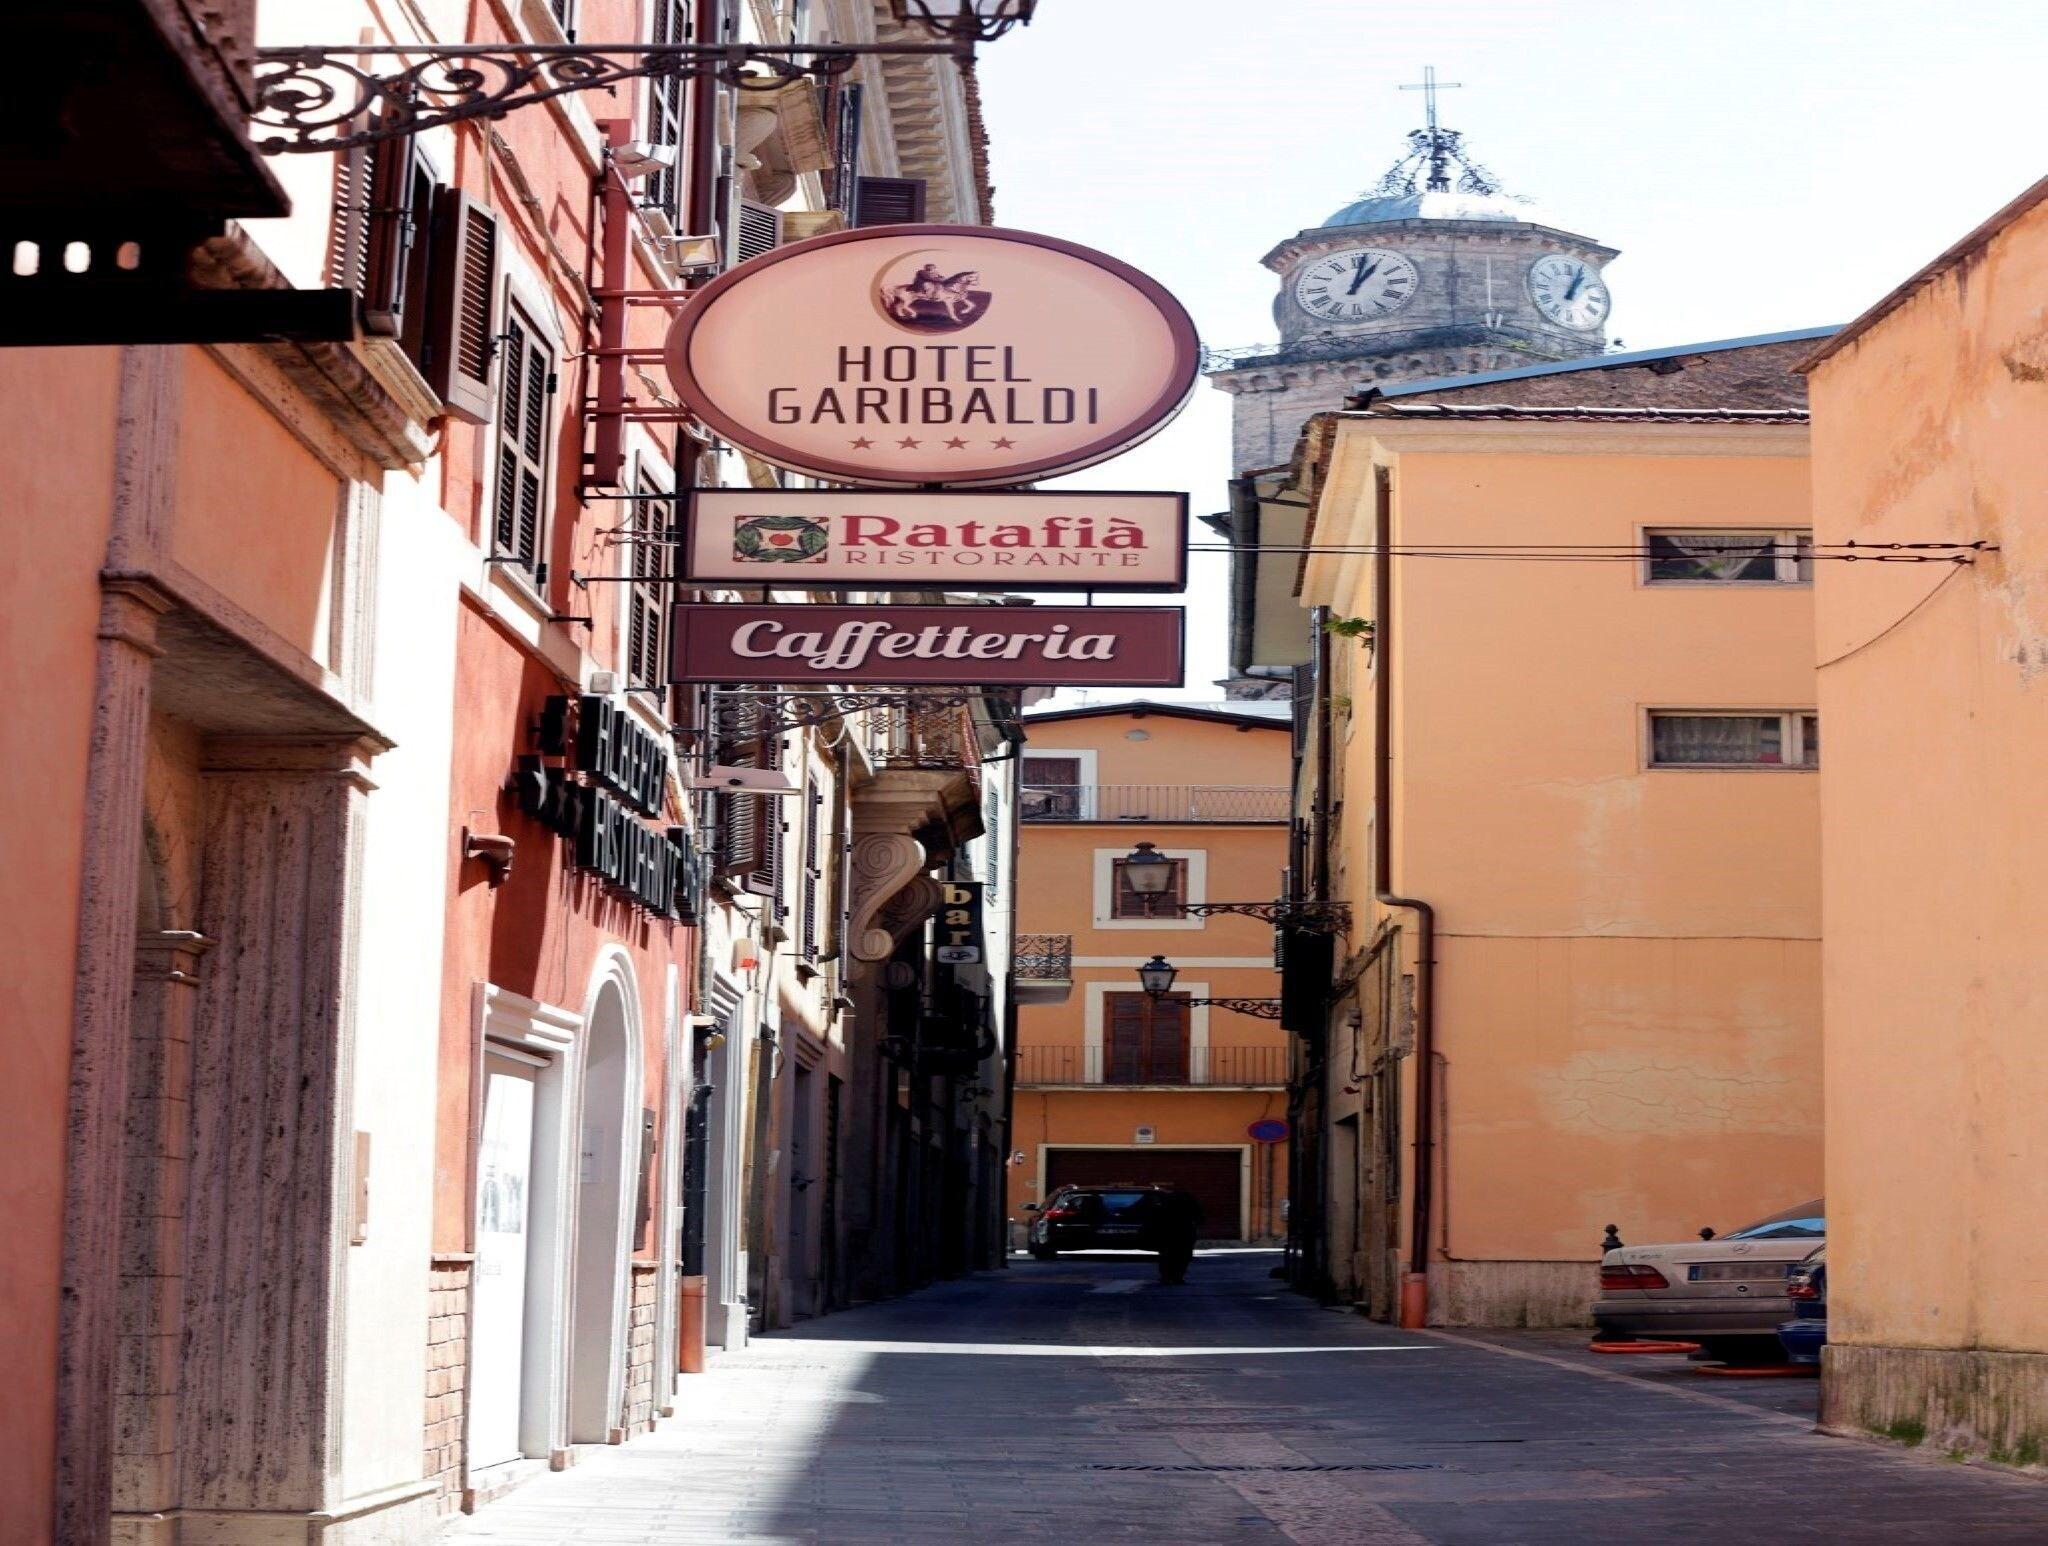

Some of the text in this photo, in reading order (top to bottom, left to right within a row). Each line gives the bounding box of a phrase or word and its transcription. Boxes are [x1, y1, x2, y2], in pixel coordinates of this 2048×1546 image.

[839, 345, 1031, 382] HOTEL
[768, 387, 1098, 424] GARIBALDI
[840, 514, 1148, 549] Ratafià
[845, 551, 1141, 566] RISTORANTE
[731, 620, 1116, 669] Caffetteria
[942, 883, 972, 945] bar
